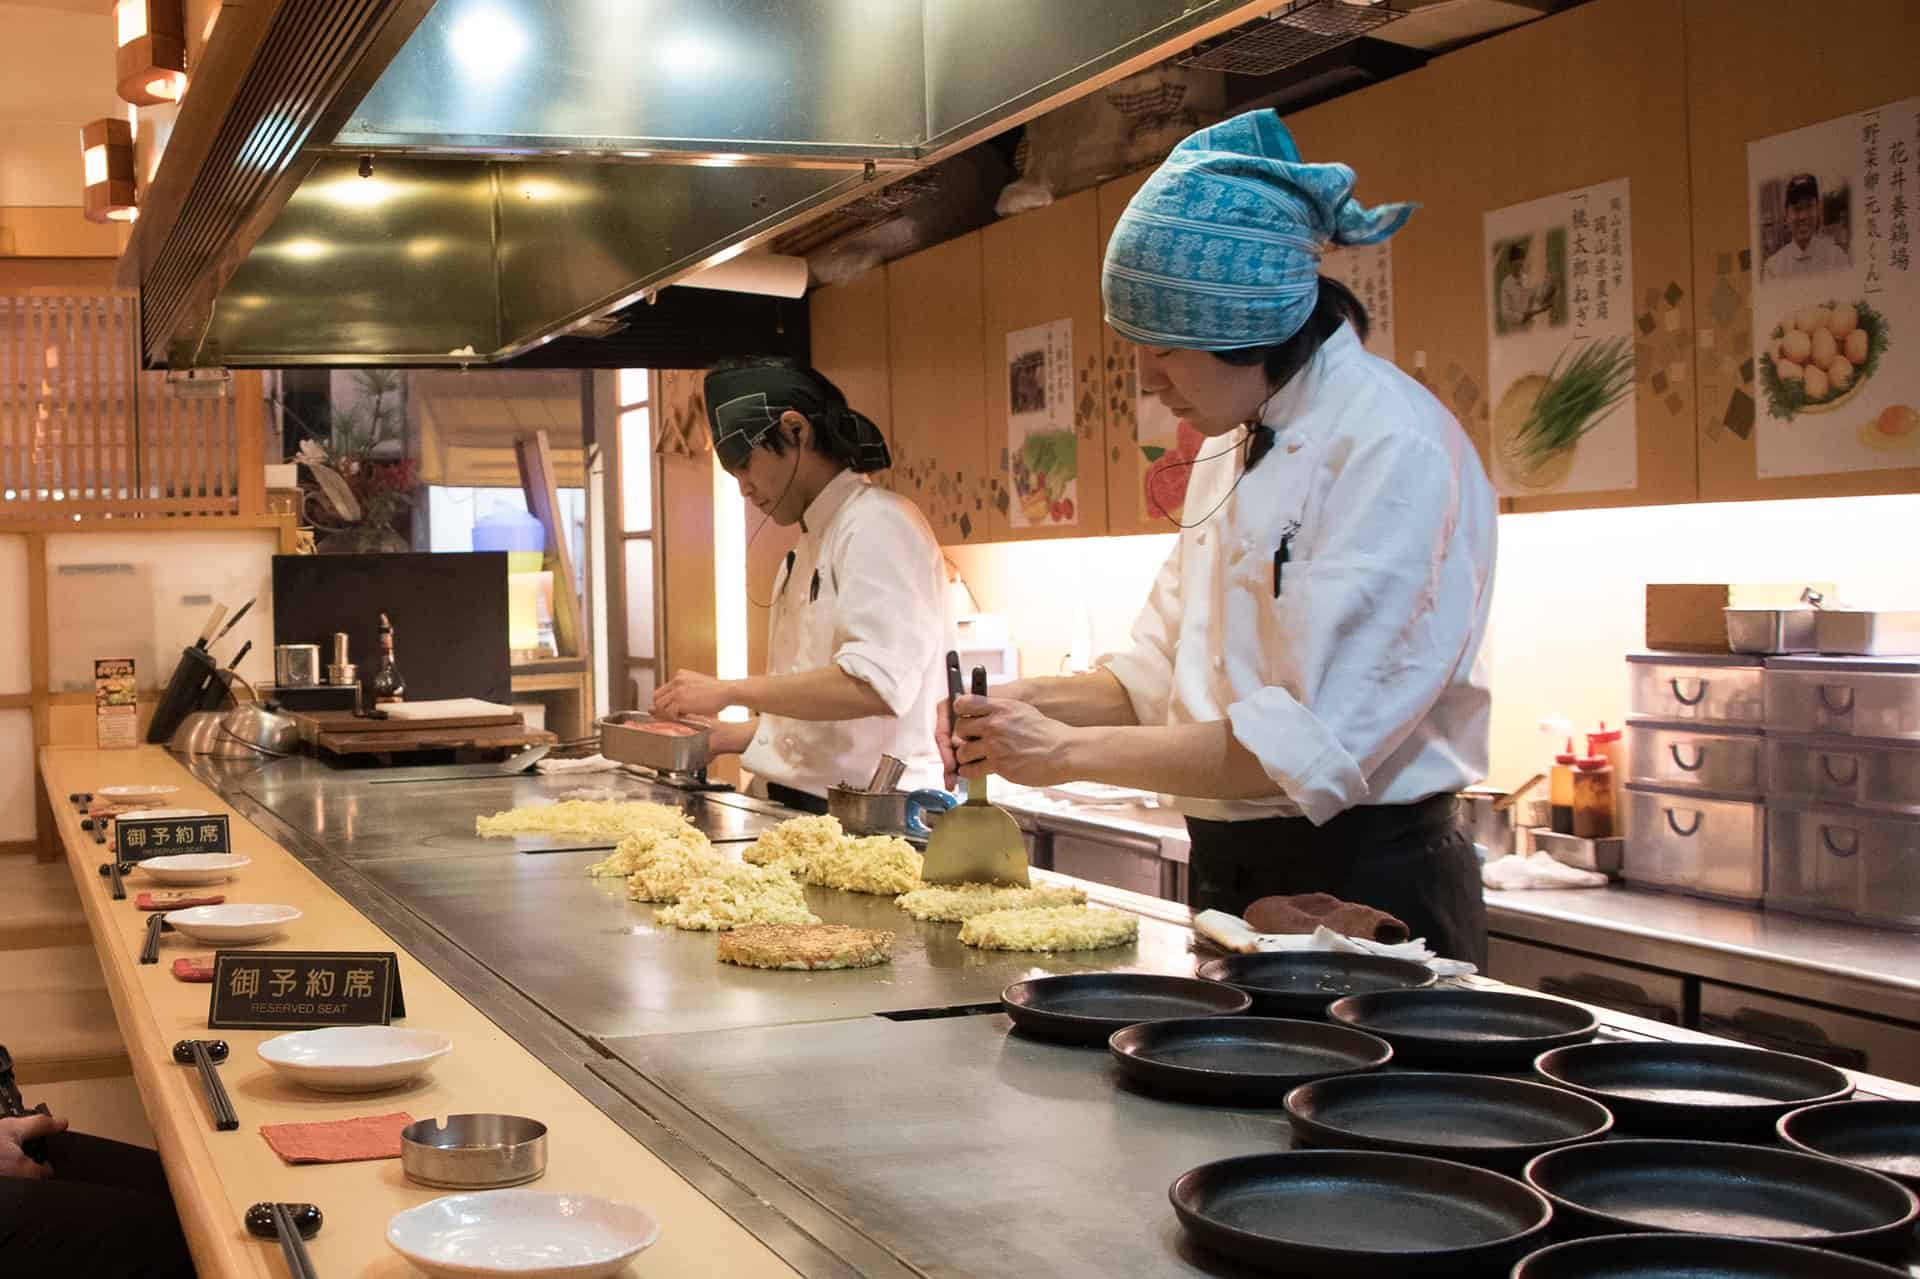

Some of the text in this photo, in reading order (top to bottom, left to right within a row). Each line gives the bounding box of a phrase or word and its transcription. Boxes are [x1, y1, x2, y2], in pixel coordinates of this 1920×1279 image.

[126, 825, 219, 847] 御予約席
[230, 968, 375, 999] 御予約席
[252, 1003, 348, 1014] RESERVED SEAT
